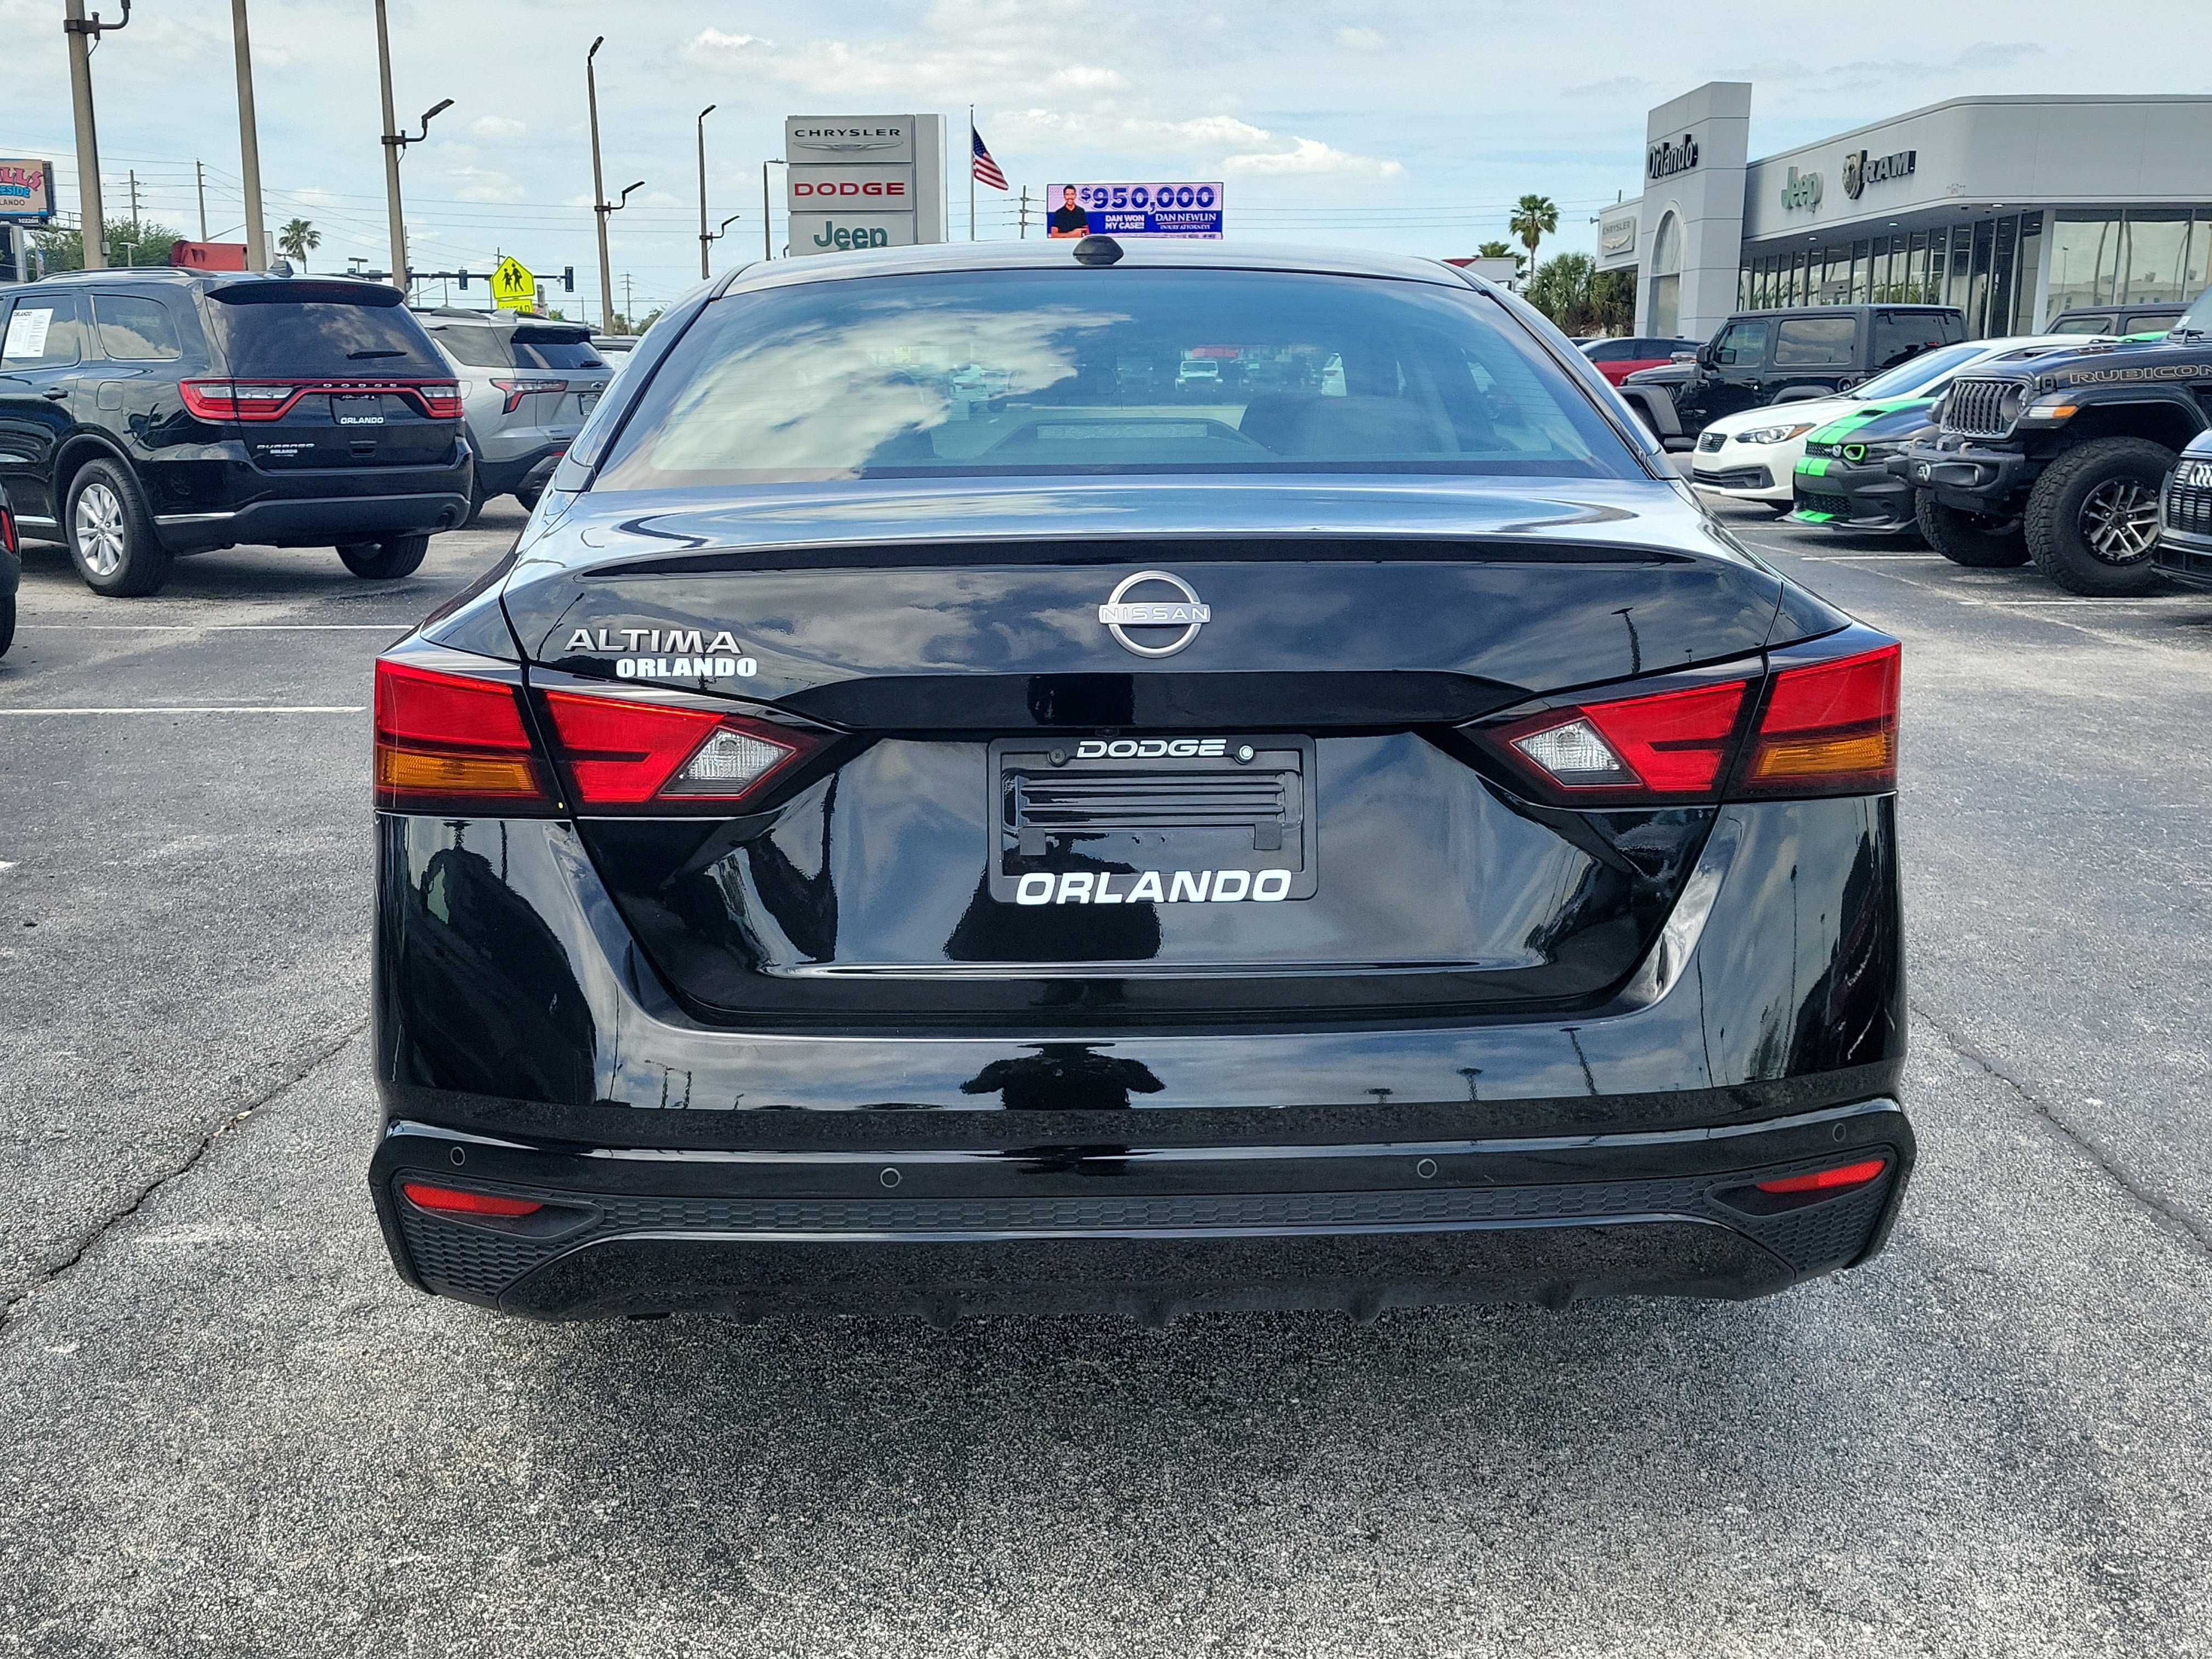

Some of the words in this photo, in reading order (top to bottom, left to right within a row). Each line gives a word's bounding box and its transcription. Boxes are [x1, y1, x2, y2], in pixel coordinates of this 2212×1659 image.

[1647, 133, 1698, 179] Orlando
[0, 167, 44, 191] LLS
[794, 182, 905, 196] DODGE
[1781, 166, 1824, 213] Jeep
[1081, 185, 1215, 213] $950,000
[1155, 213, 1176, 222] DAN
[1177, 213, 1216, 221] NEWLIN
[1602, 221, 1630, 235] CHRYSLER
[814, 221, 888, 249] Jeep
[1102, 607, 1207, 621] NISSAN
[564, 629, 743, 654] ALTIMA
[616, 658, 758, 678] ORLANDO
[1076, 739, 1227, 758] DODGE
[1016, 869, 1292, 905] ORLANDO
